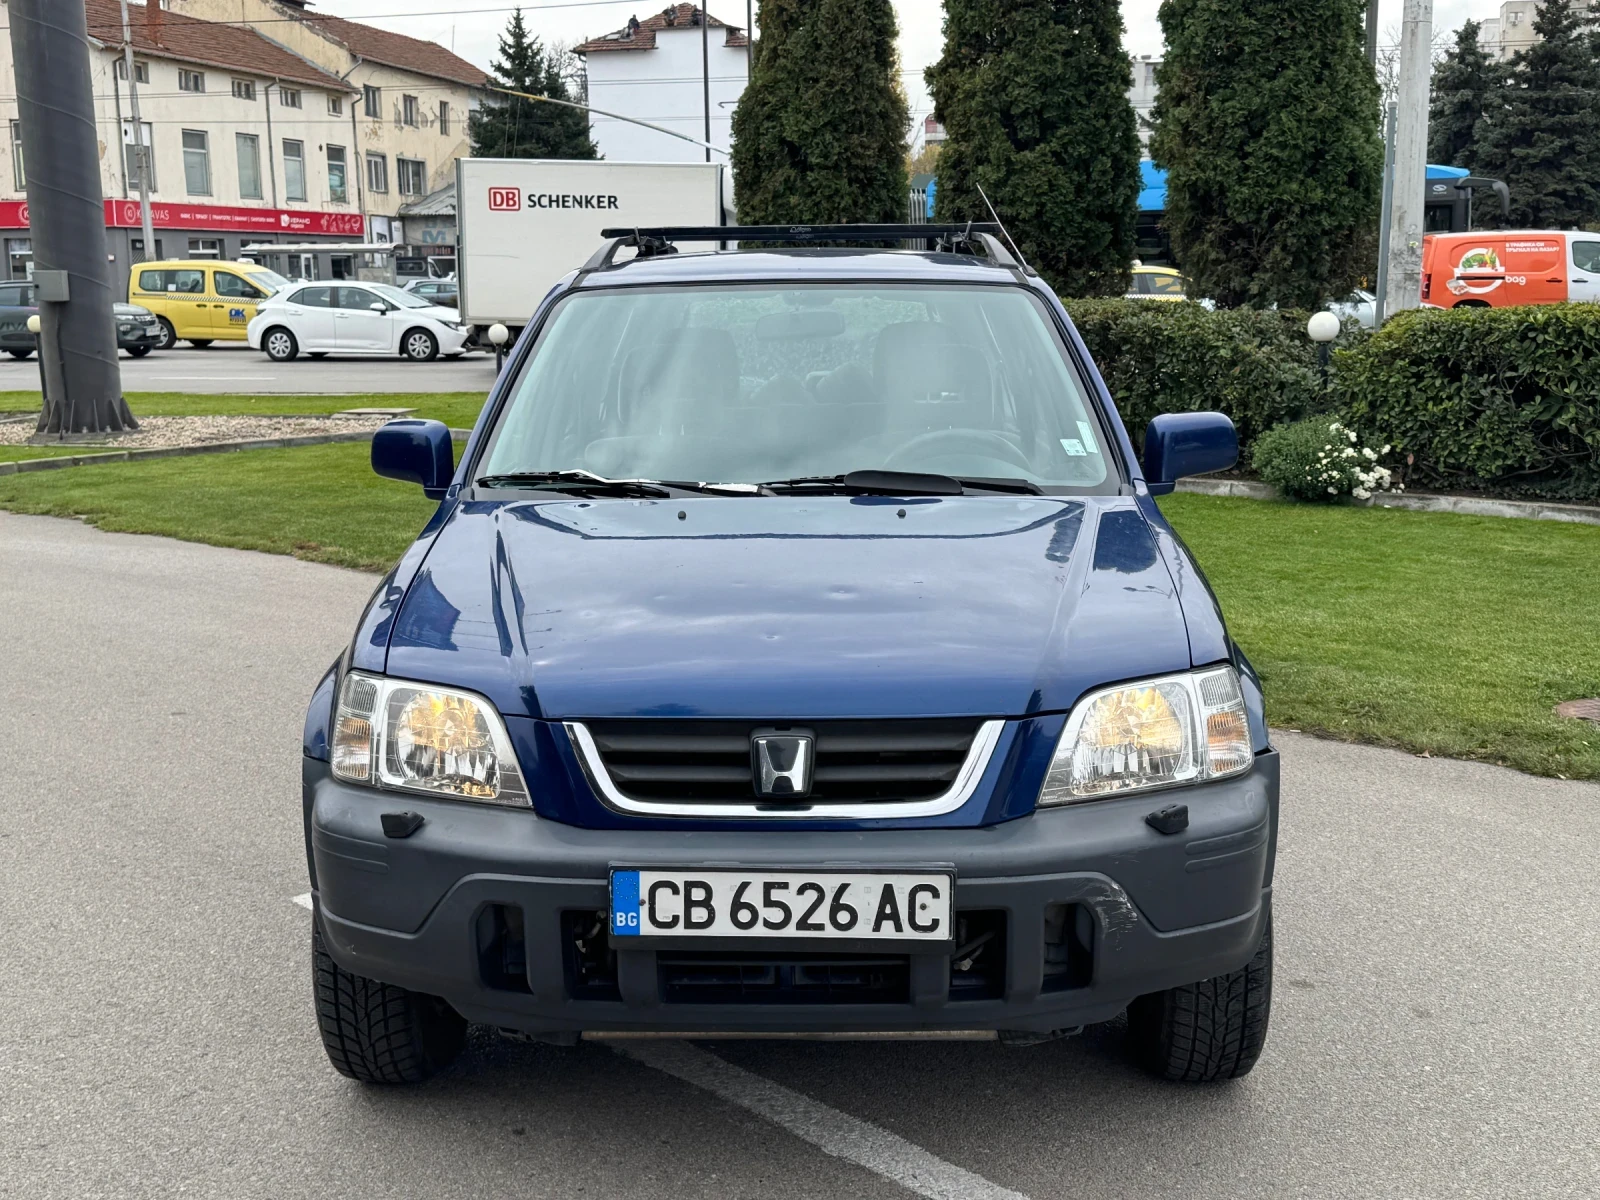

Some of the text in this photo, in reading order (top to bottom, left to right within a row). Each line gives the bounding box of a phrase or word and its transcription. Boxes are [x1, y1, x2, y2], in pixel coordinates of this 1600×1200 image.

[493, 191, 619, 210] DB SCHENKER
[136, 209, 169, 221] KAVAS
[229, 308, 246, 318] OK
[648, 880, 941, 933] CB 6526 AC
[616, 911, 638, 927] BG
